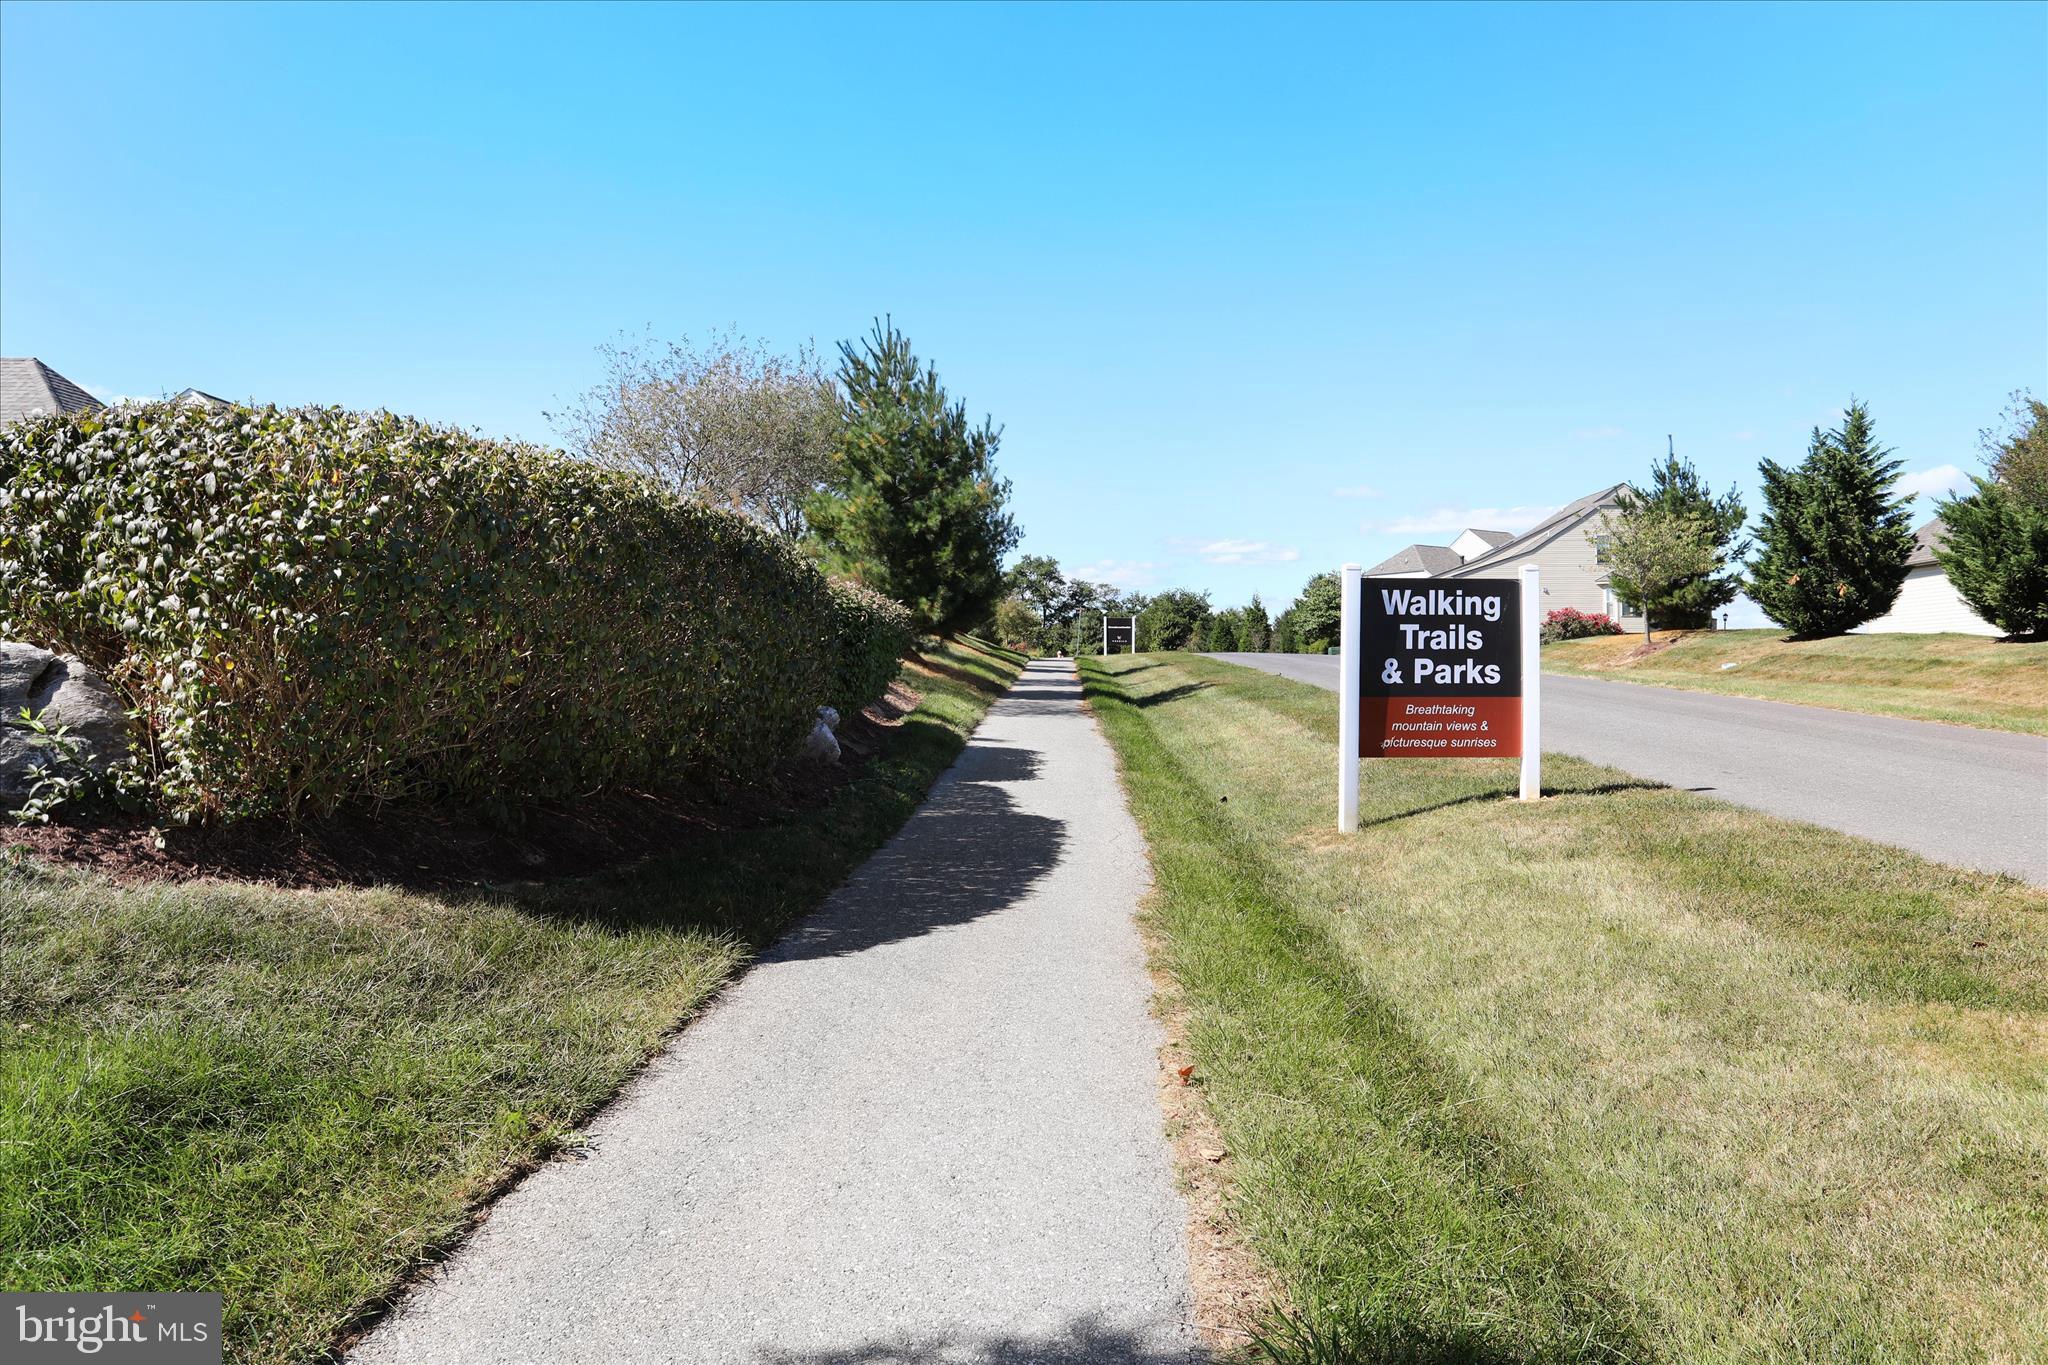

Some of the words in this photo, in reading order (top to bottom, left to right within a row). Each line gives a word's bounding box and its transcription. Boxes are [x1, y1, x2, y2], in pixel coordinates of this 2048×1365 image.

[1381, 589, 1501, 622] Walking
[1399, 623, 1483, 650] Trails
[1381, 657, 1404, 684] &
[1414, 657, 1501, 684] Parks
[1405, 704, 1475, 717] Breathtaking
[1391, 721, 1443, 731] mountain
[1446, 721, 1477, 731] views
[1480, 720, 1489, 731] &
[1383, 736, 1447, 749] picturesque
[1450, 737, 1497, 747] sunrises
